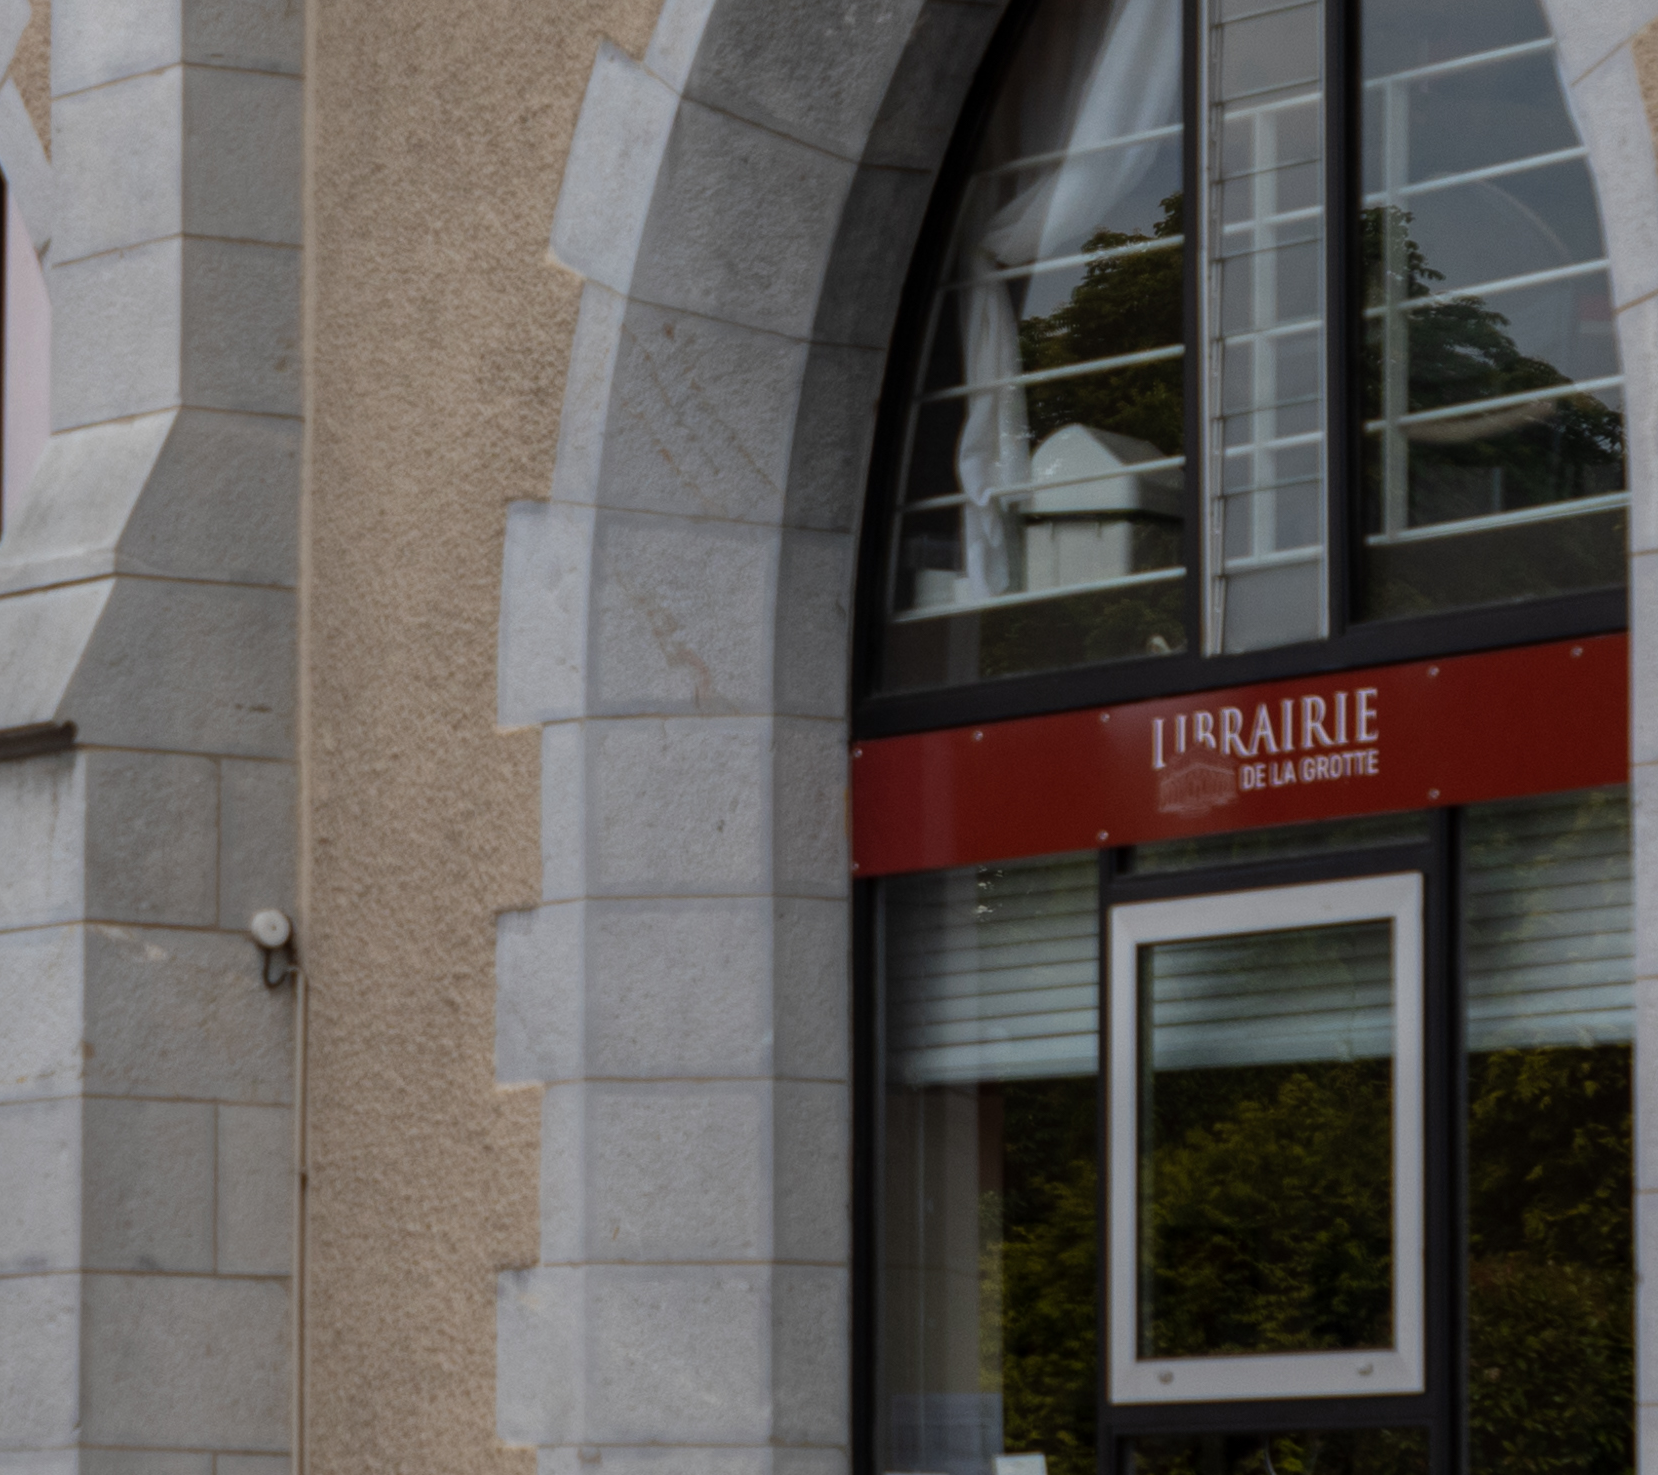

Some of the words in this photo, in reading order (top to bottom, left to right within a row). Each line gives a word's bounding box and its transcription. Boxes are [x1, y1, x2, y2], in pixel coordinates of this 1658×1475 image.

[1152, 688, 1380, 770] LIBRAIRIE
[1239, 764, 1267, 791] DE
[1270, 760, 1297, 789] LA
[1300, 749, 1380, 783] GROTTE
